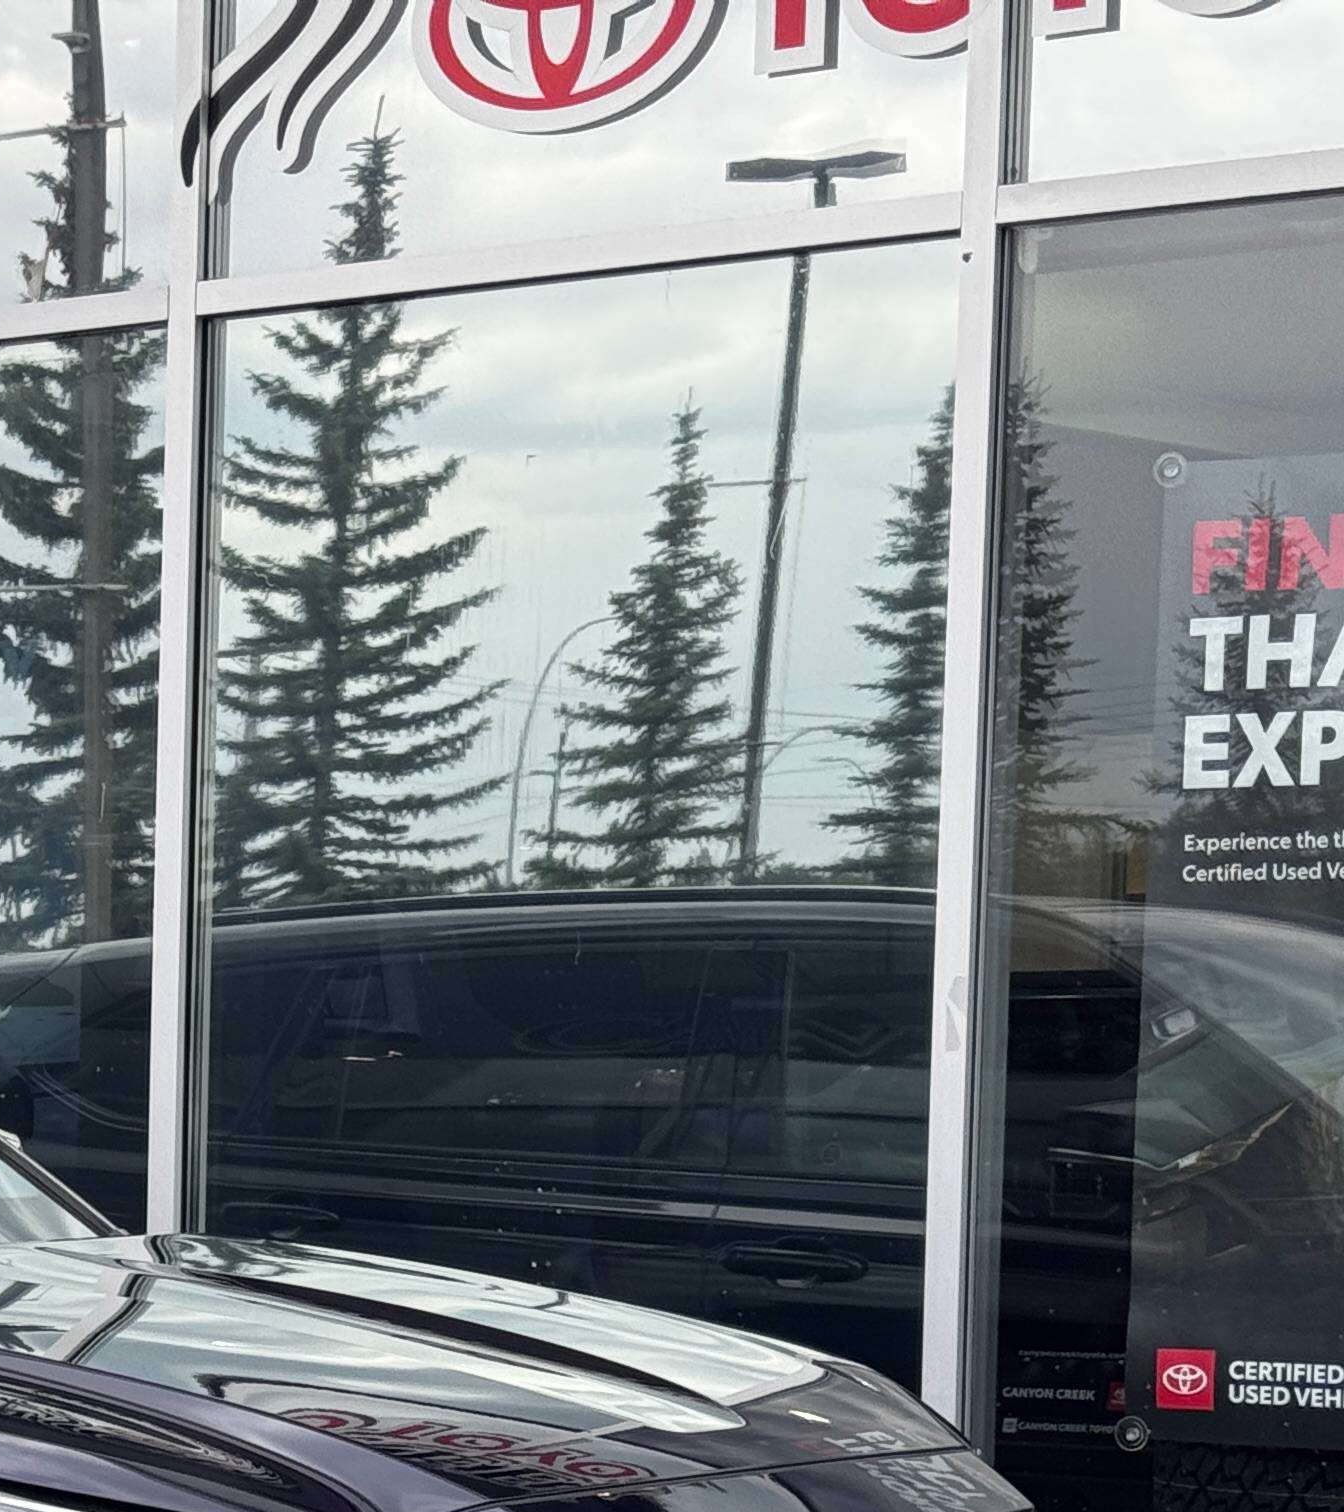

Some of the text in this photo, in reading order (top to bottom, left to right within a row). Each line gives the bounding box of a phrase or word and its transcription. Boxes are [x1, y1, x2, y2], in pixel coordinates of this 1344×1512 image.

[1184, 831, 1292, 856] Experience
[1296, 831, 1329, 849] the
[1182, 862, 1267, 882] Certified
[1273, 862, 1322, 880] Used
[1228, 1360, 1344, 1384] CERTIFIED
[1002, 1387, 1095, 1401] CANYON CREEK
[1228, 1384, 1291, 1406] USED
